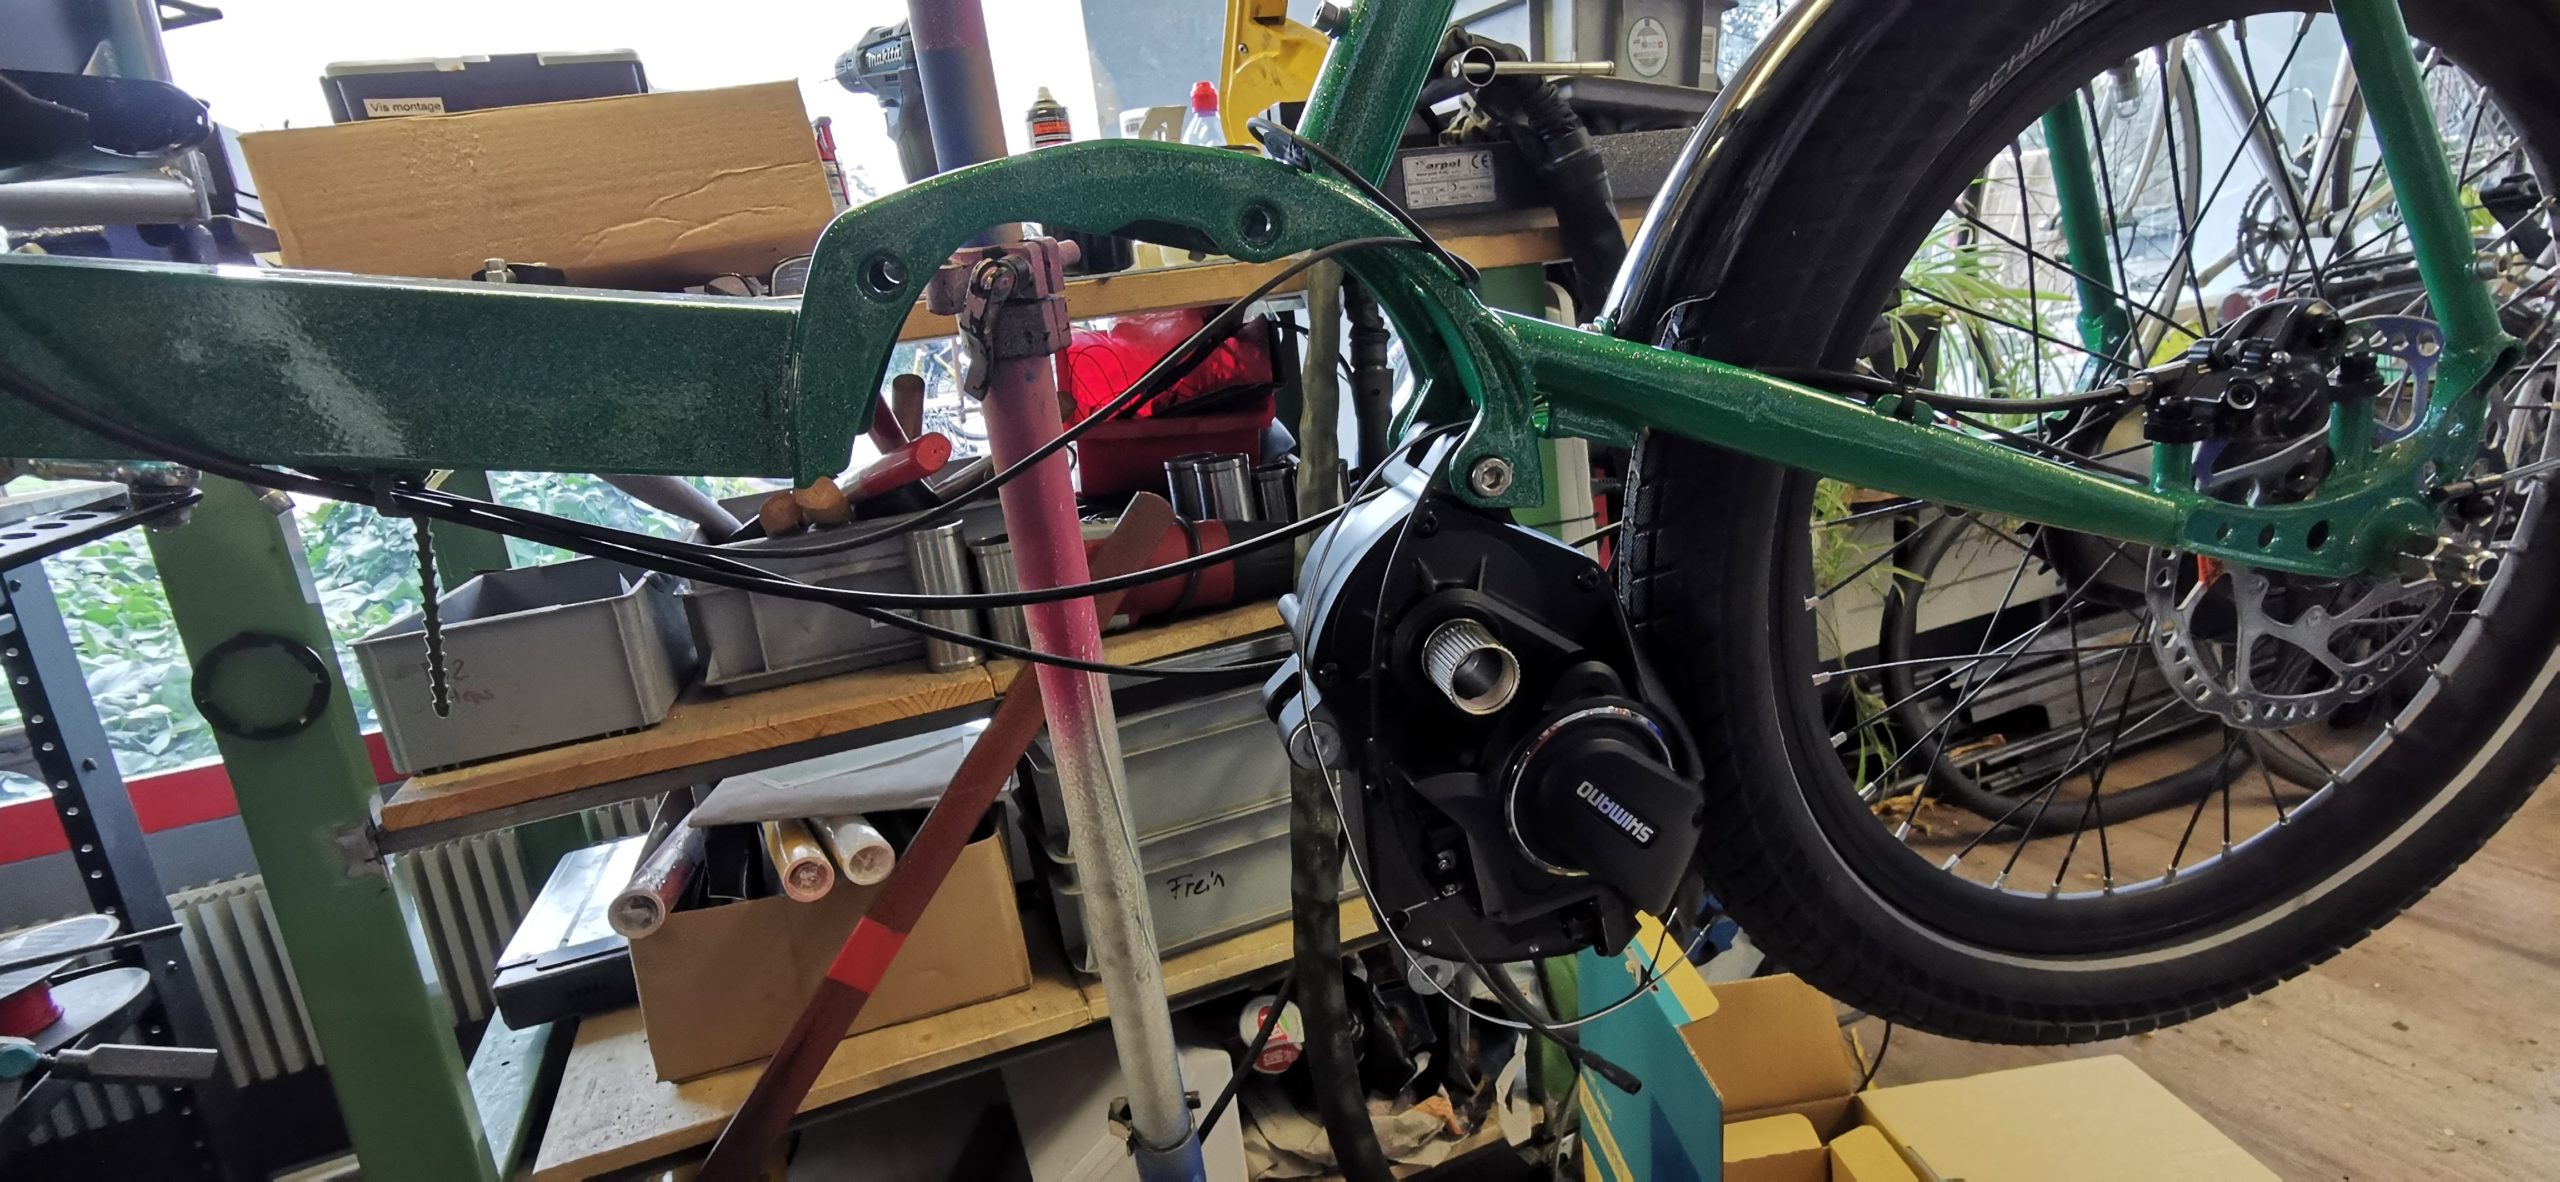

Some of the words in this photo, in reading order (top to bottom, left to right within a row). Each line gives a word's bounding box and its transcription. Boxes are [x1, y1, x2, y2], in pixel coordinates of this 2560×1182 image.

[1966, 0, 2097, 114] SCHWAL
[370, 103, 390, 112] Vis
[392, 102, 442, 112] montage
[1576, 780, 1655, 843] SHIMANO
